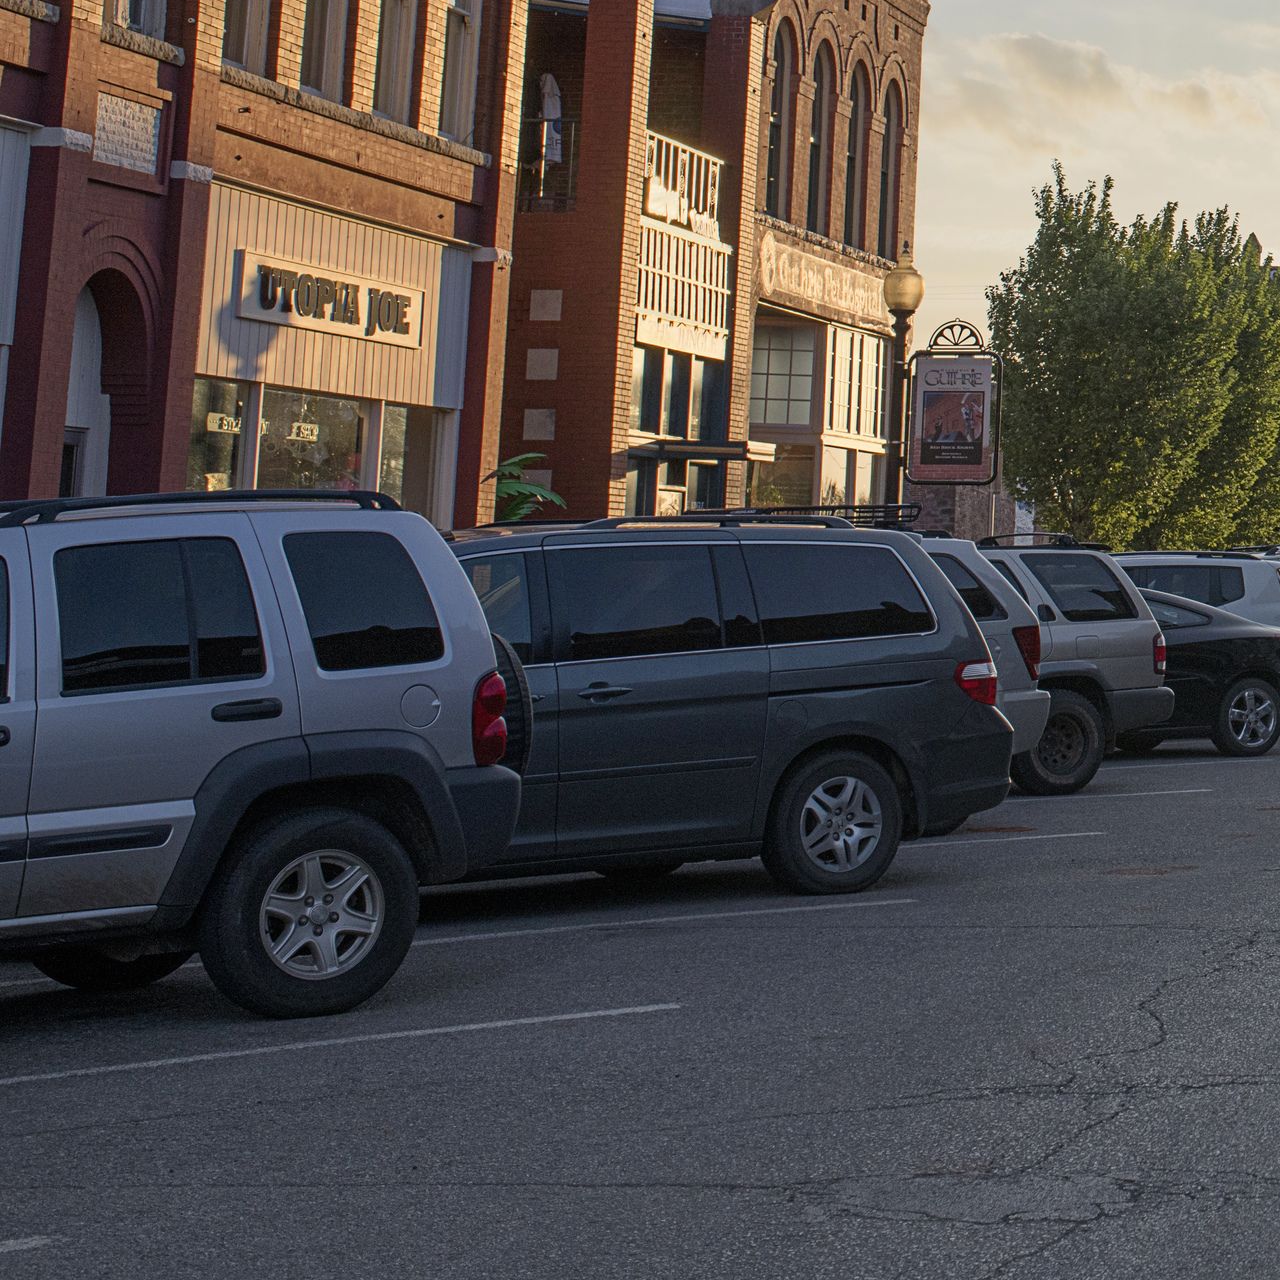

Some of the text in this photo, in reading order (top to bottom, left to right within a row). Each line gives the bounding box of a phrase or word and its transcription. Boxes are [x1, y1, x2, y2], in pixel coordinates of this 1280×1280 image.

[258, 264, 412, 336] UTOPIA JOE
[924, 369, 985, 387] GUTHRIE
